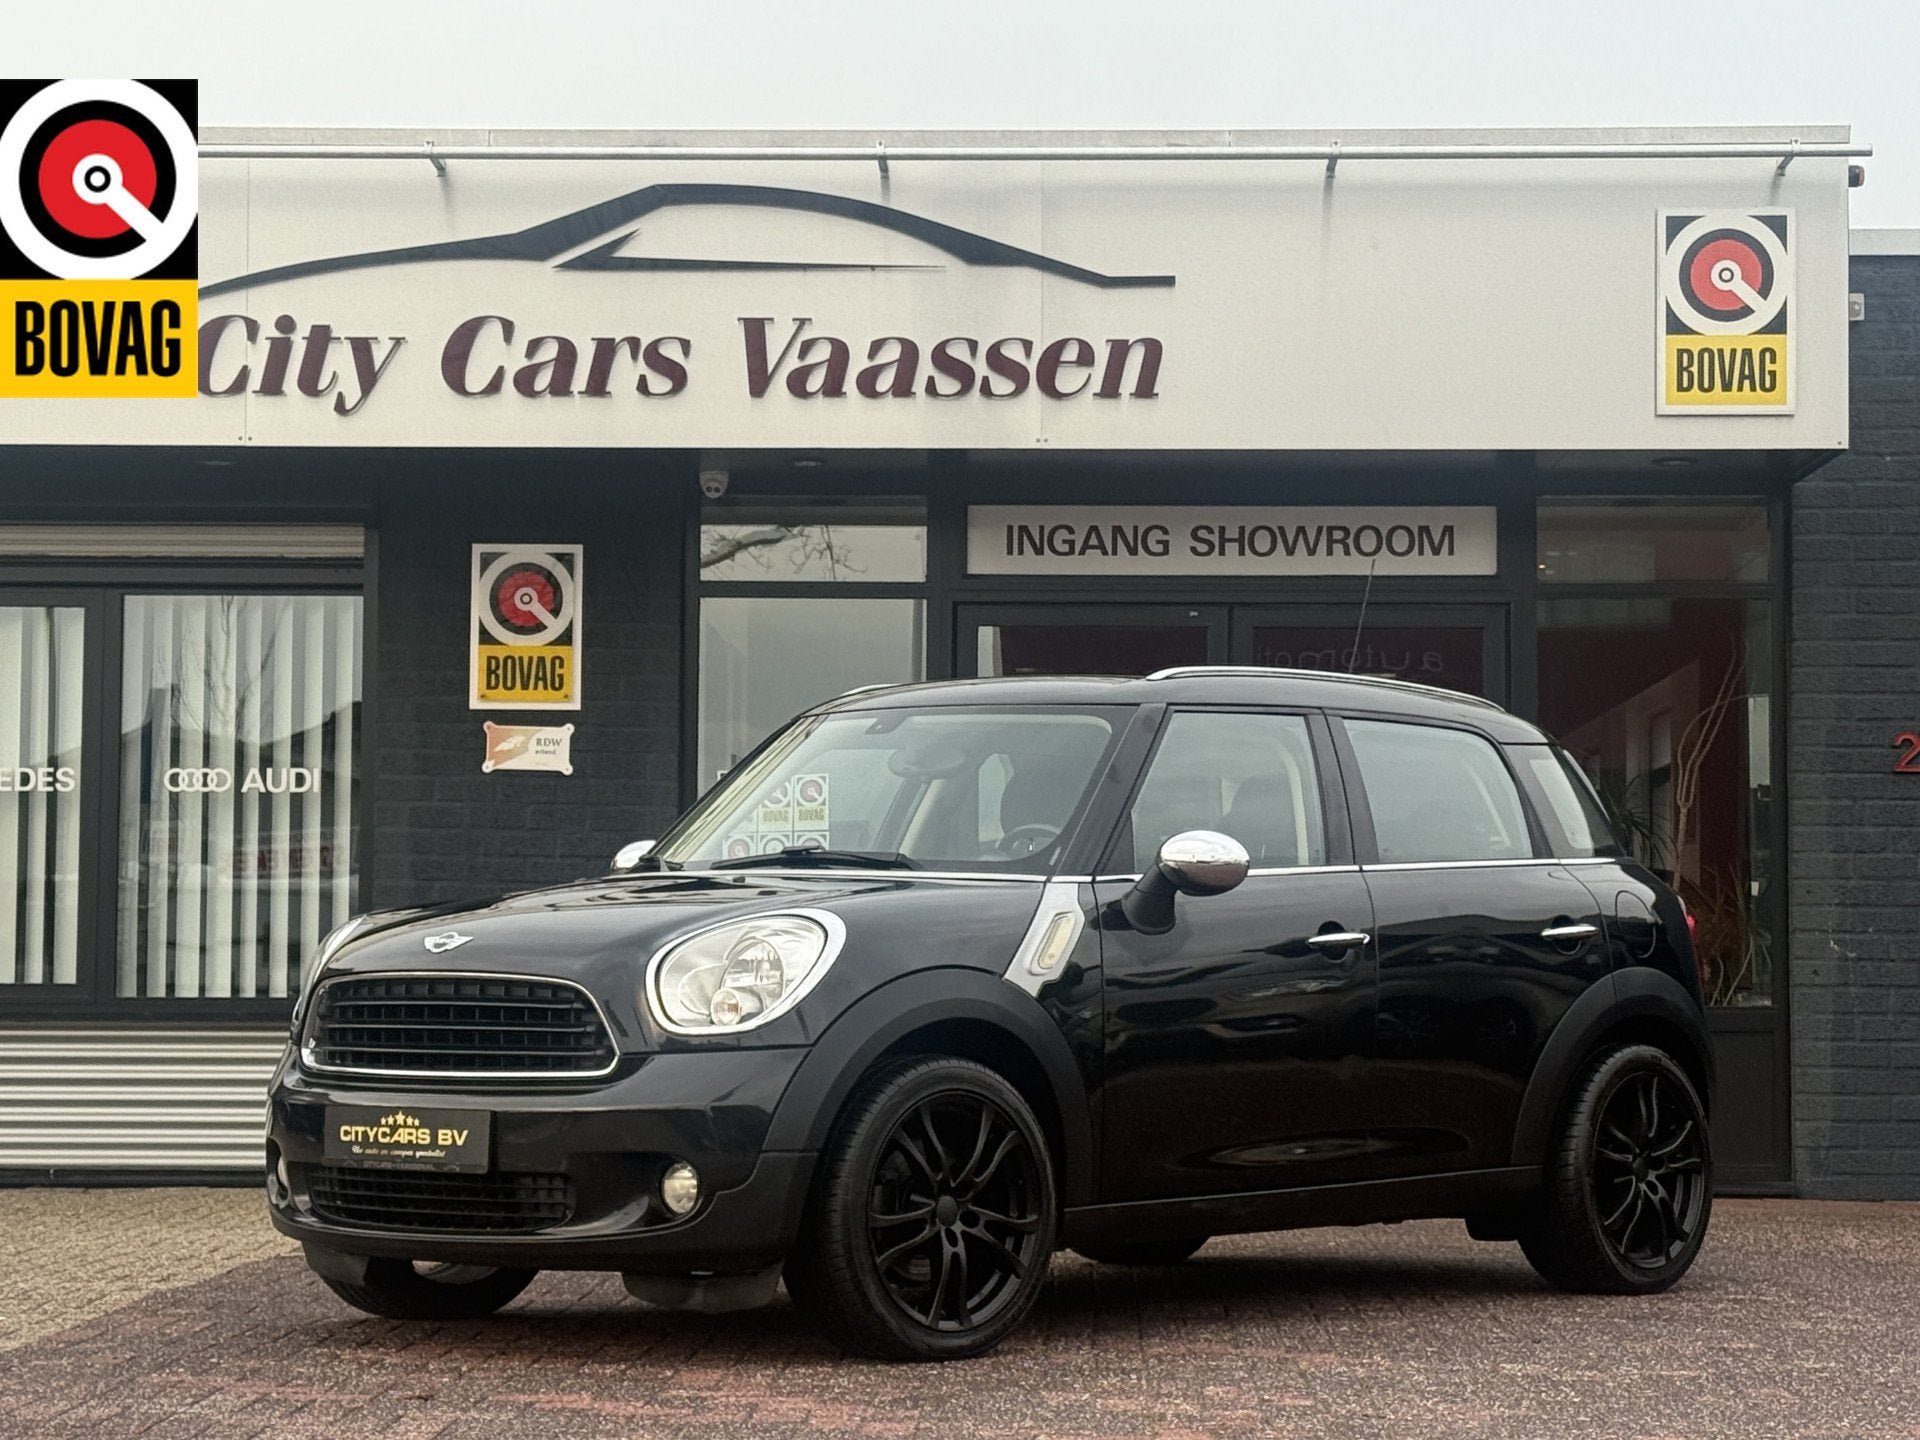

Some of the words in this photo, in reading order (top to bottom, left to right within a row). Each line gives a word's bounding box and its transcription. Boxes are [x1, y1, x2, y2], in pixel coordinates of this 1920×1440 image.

[198, 314, 406, 416] City
[440, 314, 692, 398] Cars
[737, 317, 1163, 400] Vaassen
[1676, 347, 1777, 393] BOVAG
[1006, 523, 1171, 557] INGANG
[1189, 523, 1456, 558] SHOWROOM
[486, 655, 565, 692] BOVAG
[535, 737, 563, 748] RDW
[1893, 731, 1920, 773] 2
[241, 767, 321, 794] AUDI
[798, 808, 825, 822] BOVAG
[339, 1124, 431, 1145] CITYCARS
[437, 1129, 470, 1147] BV
